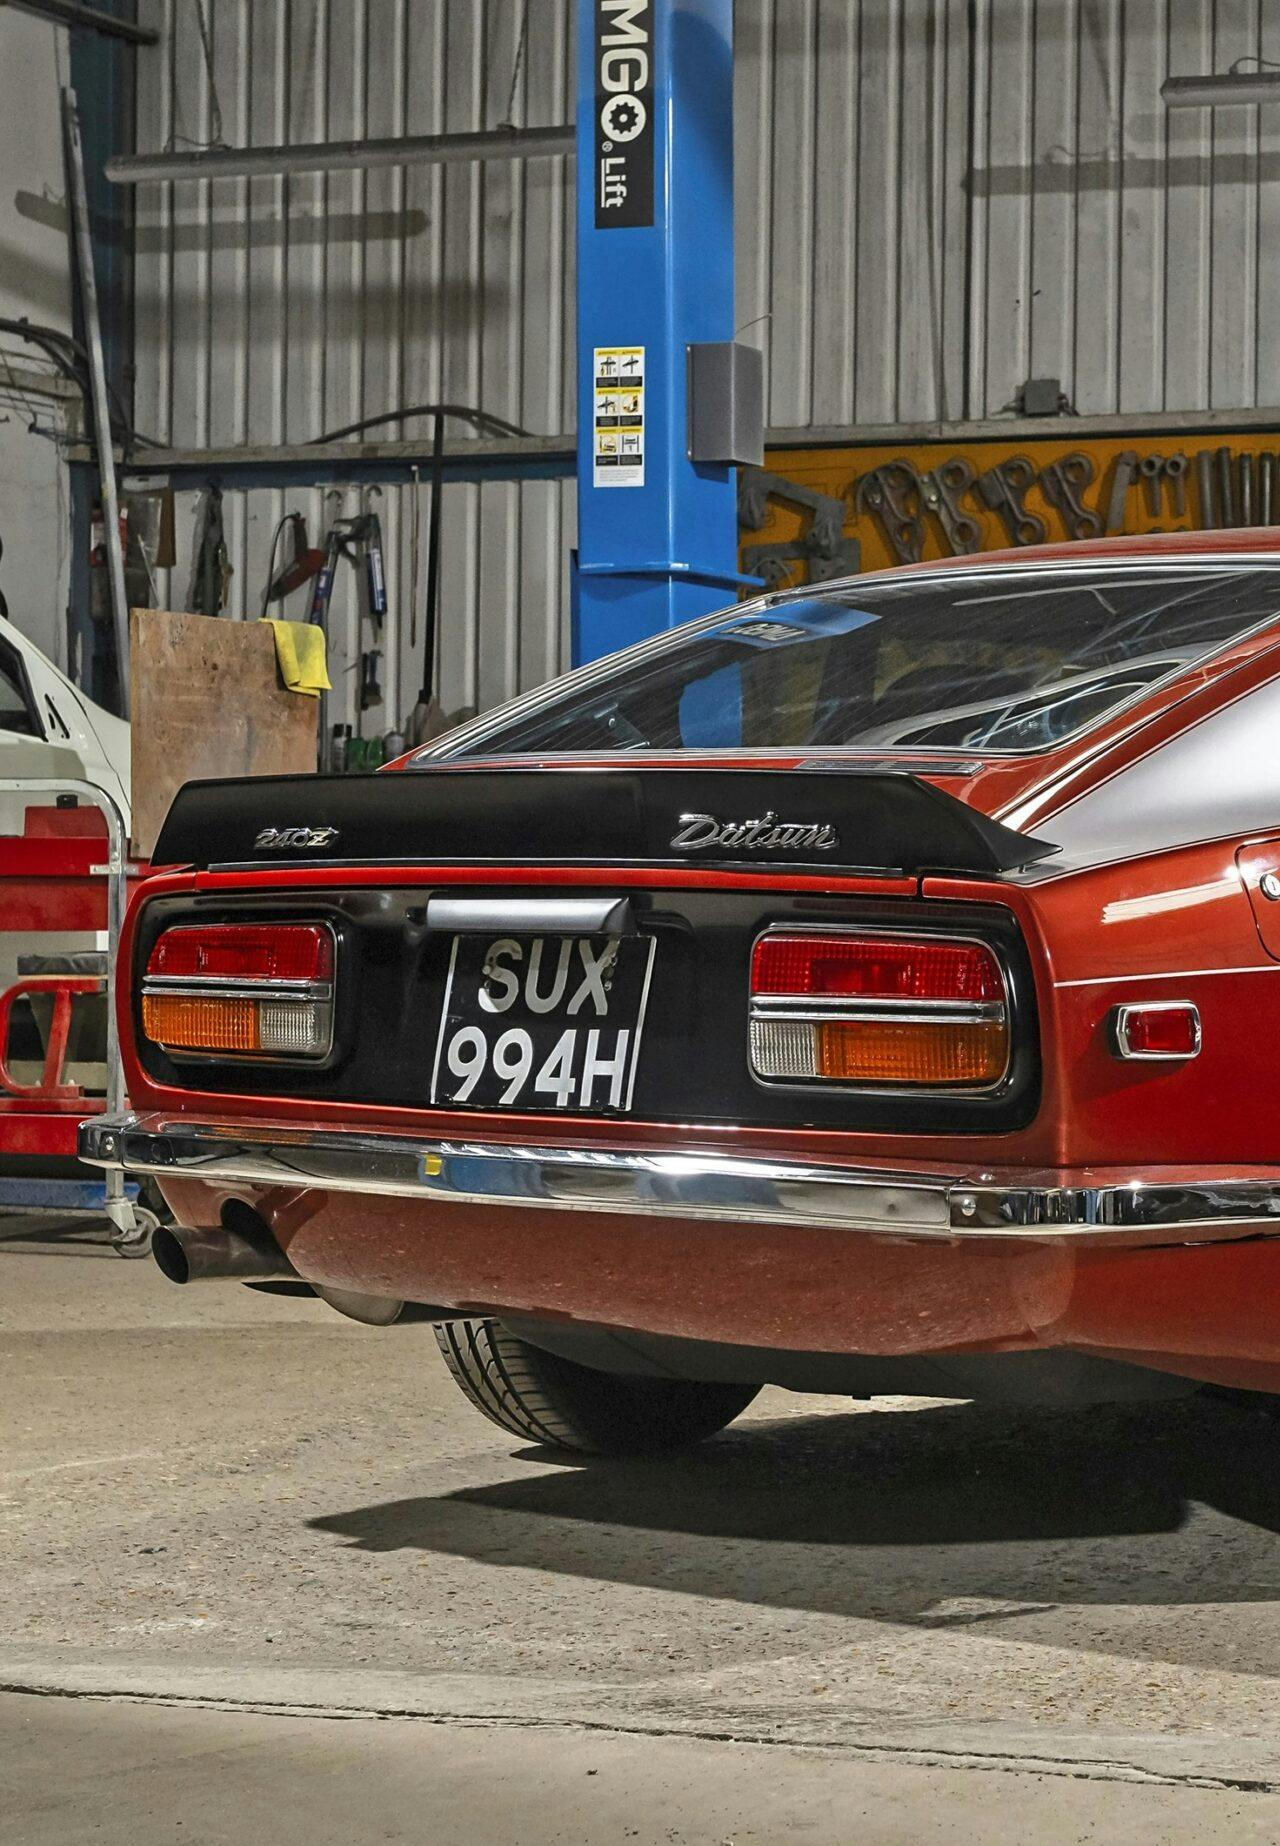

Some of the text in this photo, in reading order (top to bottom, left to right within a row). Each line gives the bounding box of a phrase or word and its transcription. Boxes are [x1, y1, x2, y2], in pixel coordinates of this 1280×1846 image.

[602, 157, 627, 208] Lift
[254, 827, 339, 849] 240Z
[670, 812, 838, 849] Datsun
[477, 938, 620, 1016] SUX
[447, 1025, 630, 1107] 994H
